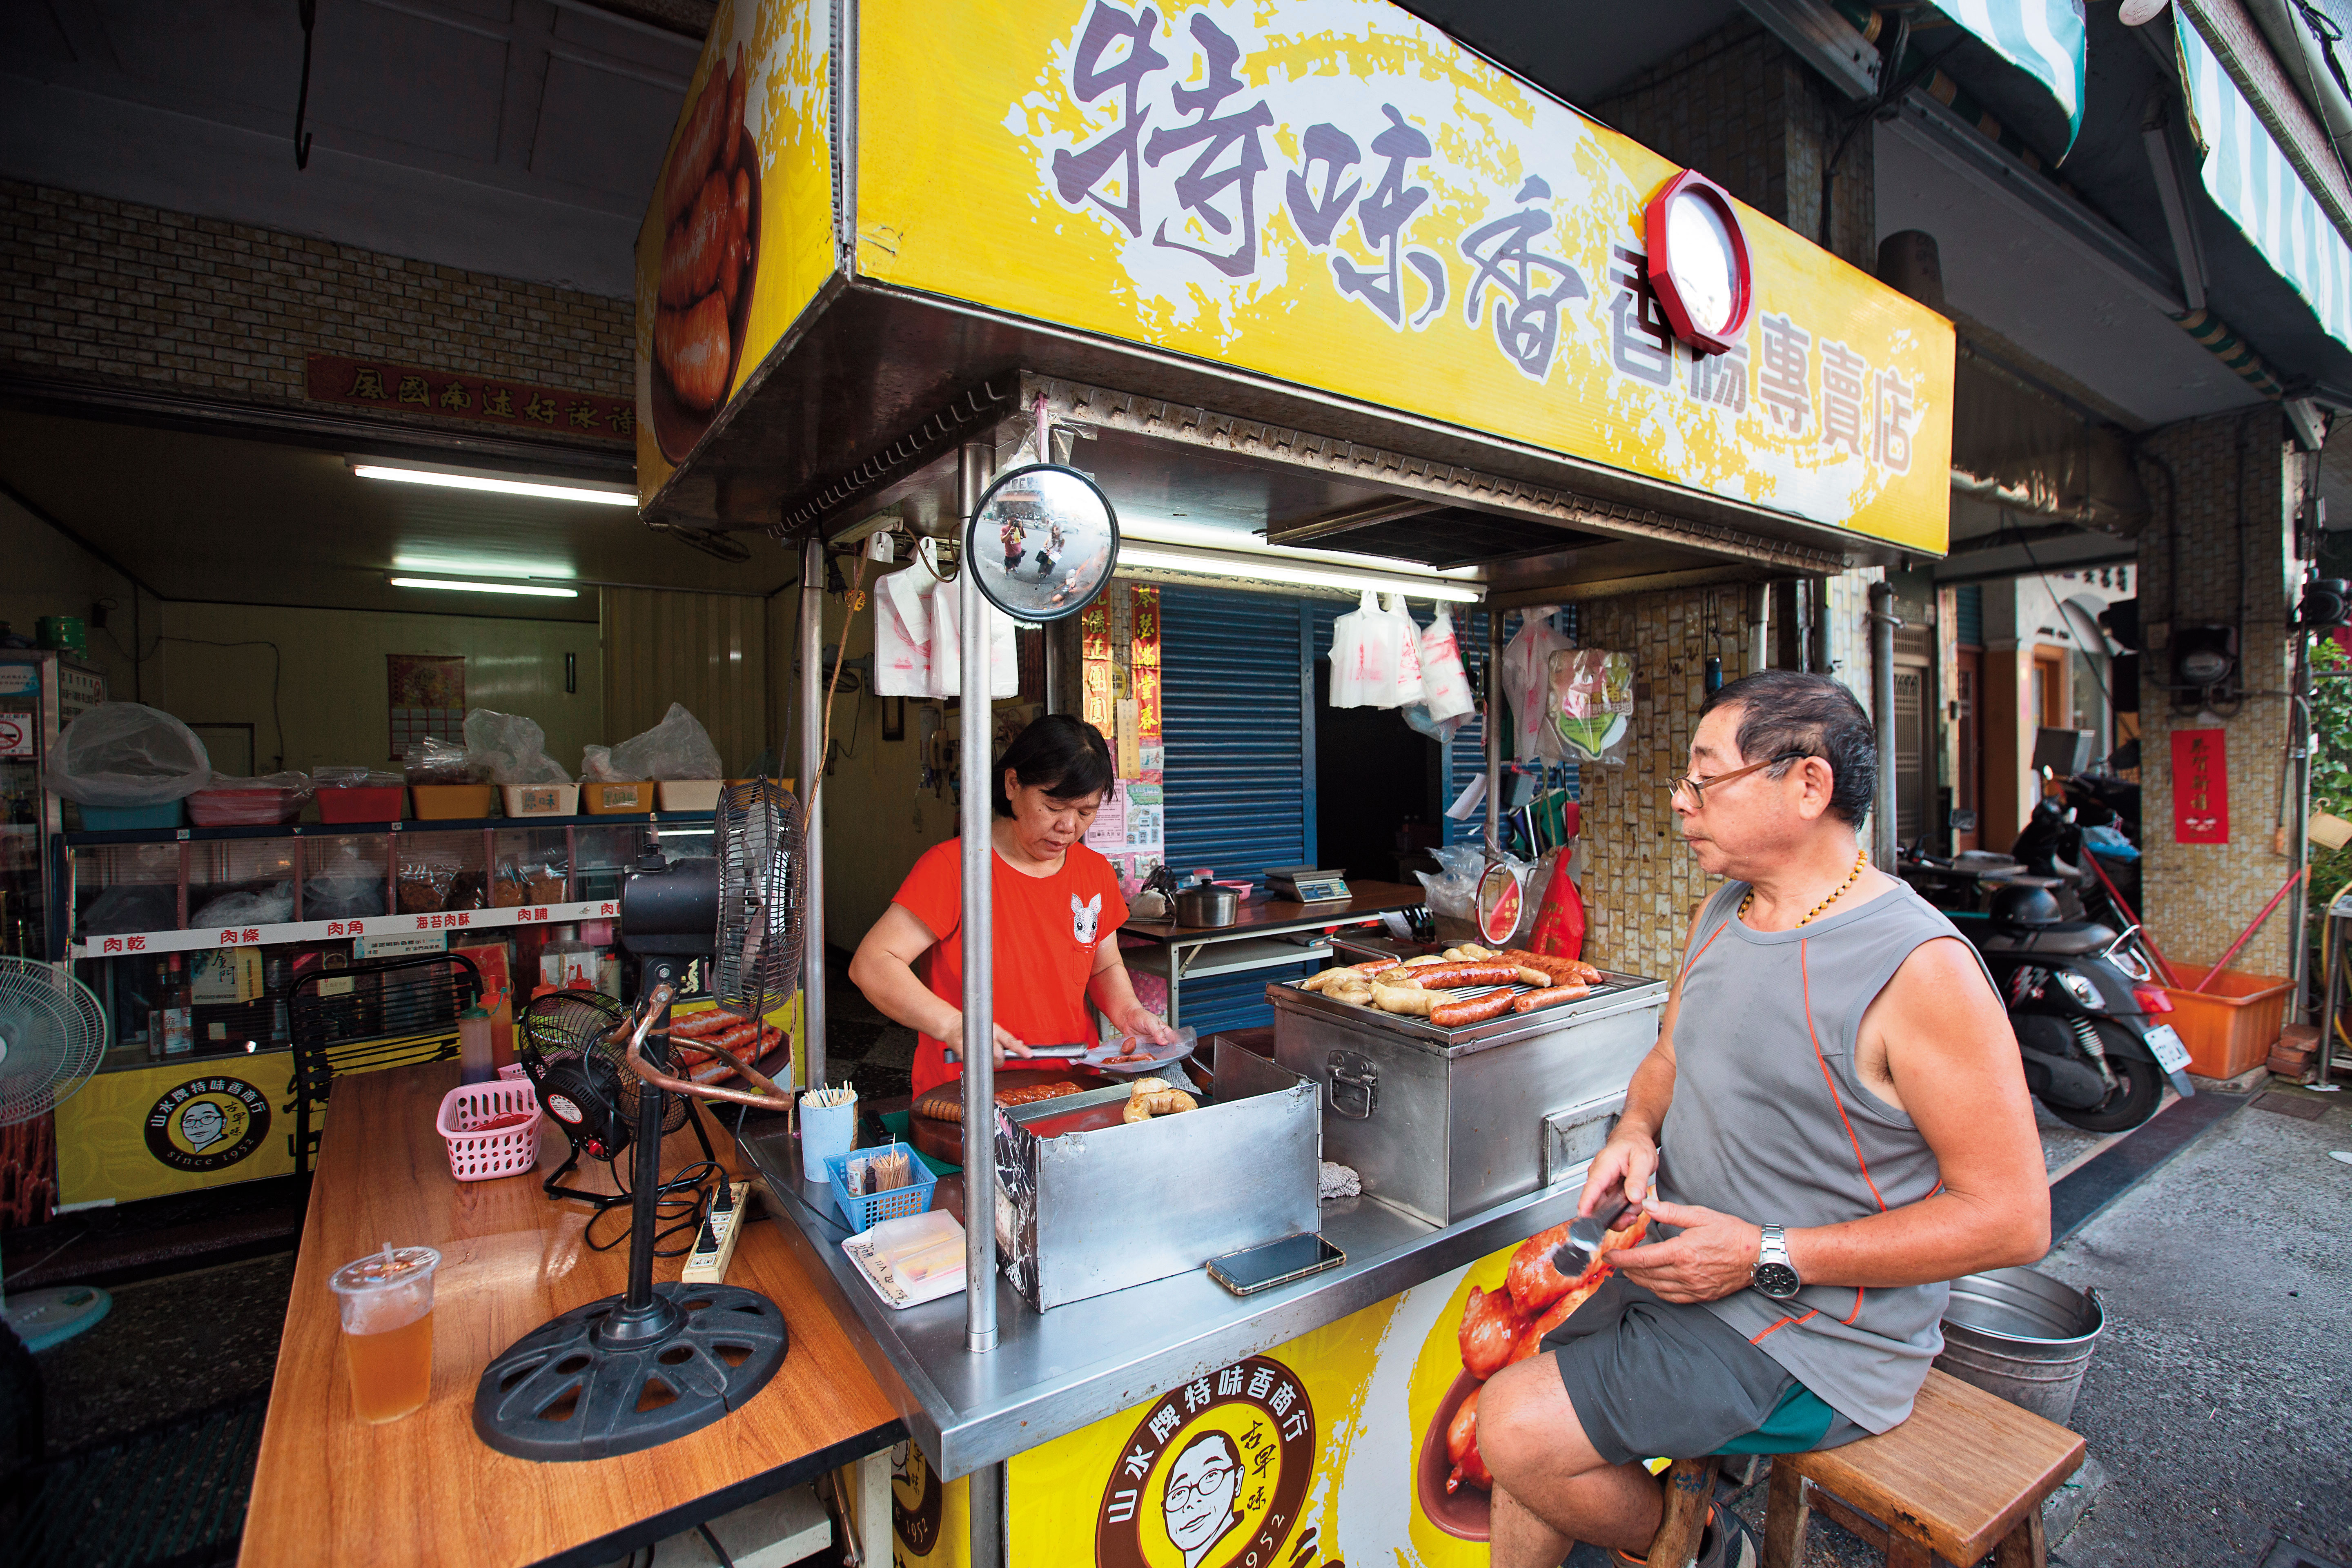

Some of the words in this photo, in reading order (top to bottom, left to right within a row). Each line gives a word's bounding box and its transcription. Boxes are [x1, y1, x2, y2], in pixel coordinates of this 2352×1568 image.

[1051, 0, 1589, 378] 特味香
[524, 793, 555, 810] 原味
[416, 913, 470, 930] 海苔肉酥
[517, 907, 548, 921] 肉脯
[601, 902, 620, 915] 肉
[220, 929, 260, 944] 肉條
[328, 921, 364, 936] 肉角
[104, 935, 146, 953] 肉乾
[151, 1079, 266, 1127] 山水牌特味香商行
[225, 1101, 247, 1136] 古早味
[167, 1151, 212, 1166] since
[223, 1139, 254, 1161] 1952
[1109, 1364, 1308, 1524] 山水牌特味香商行
[1240, 1420, 1276, 1511] 古早味
[906, 1517, 928, 1543] 1952
[1236, 1514, 1285, 1568] 952
